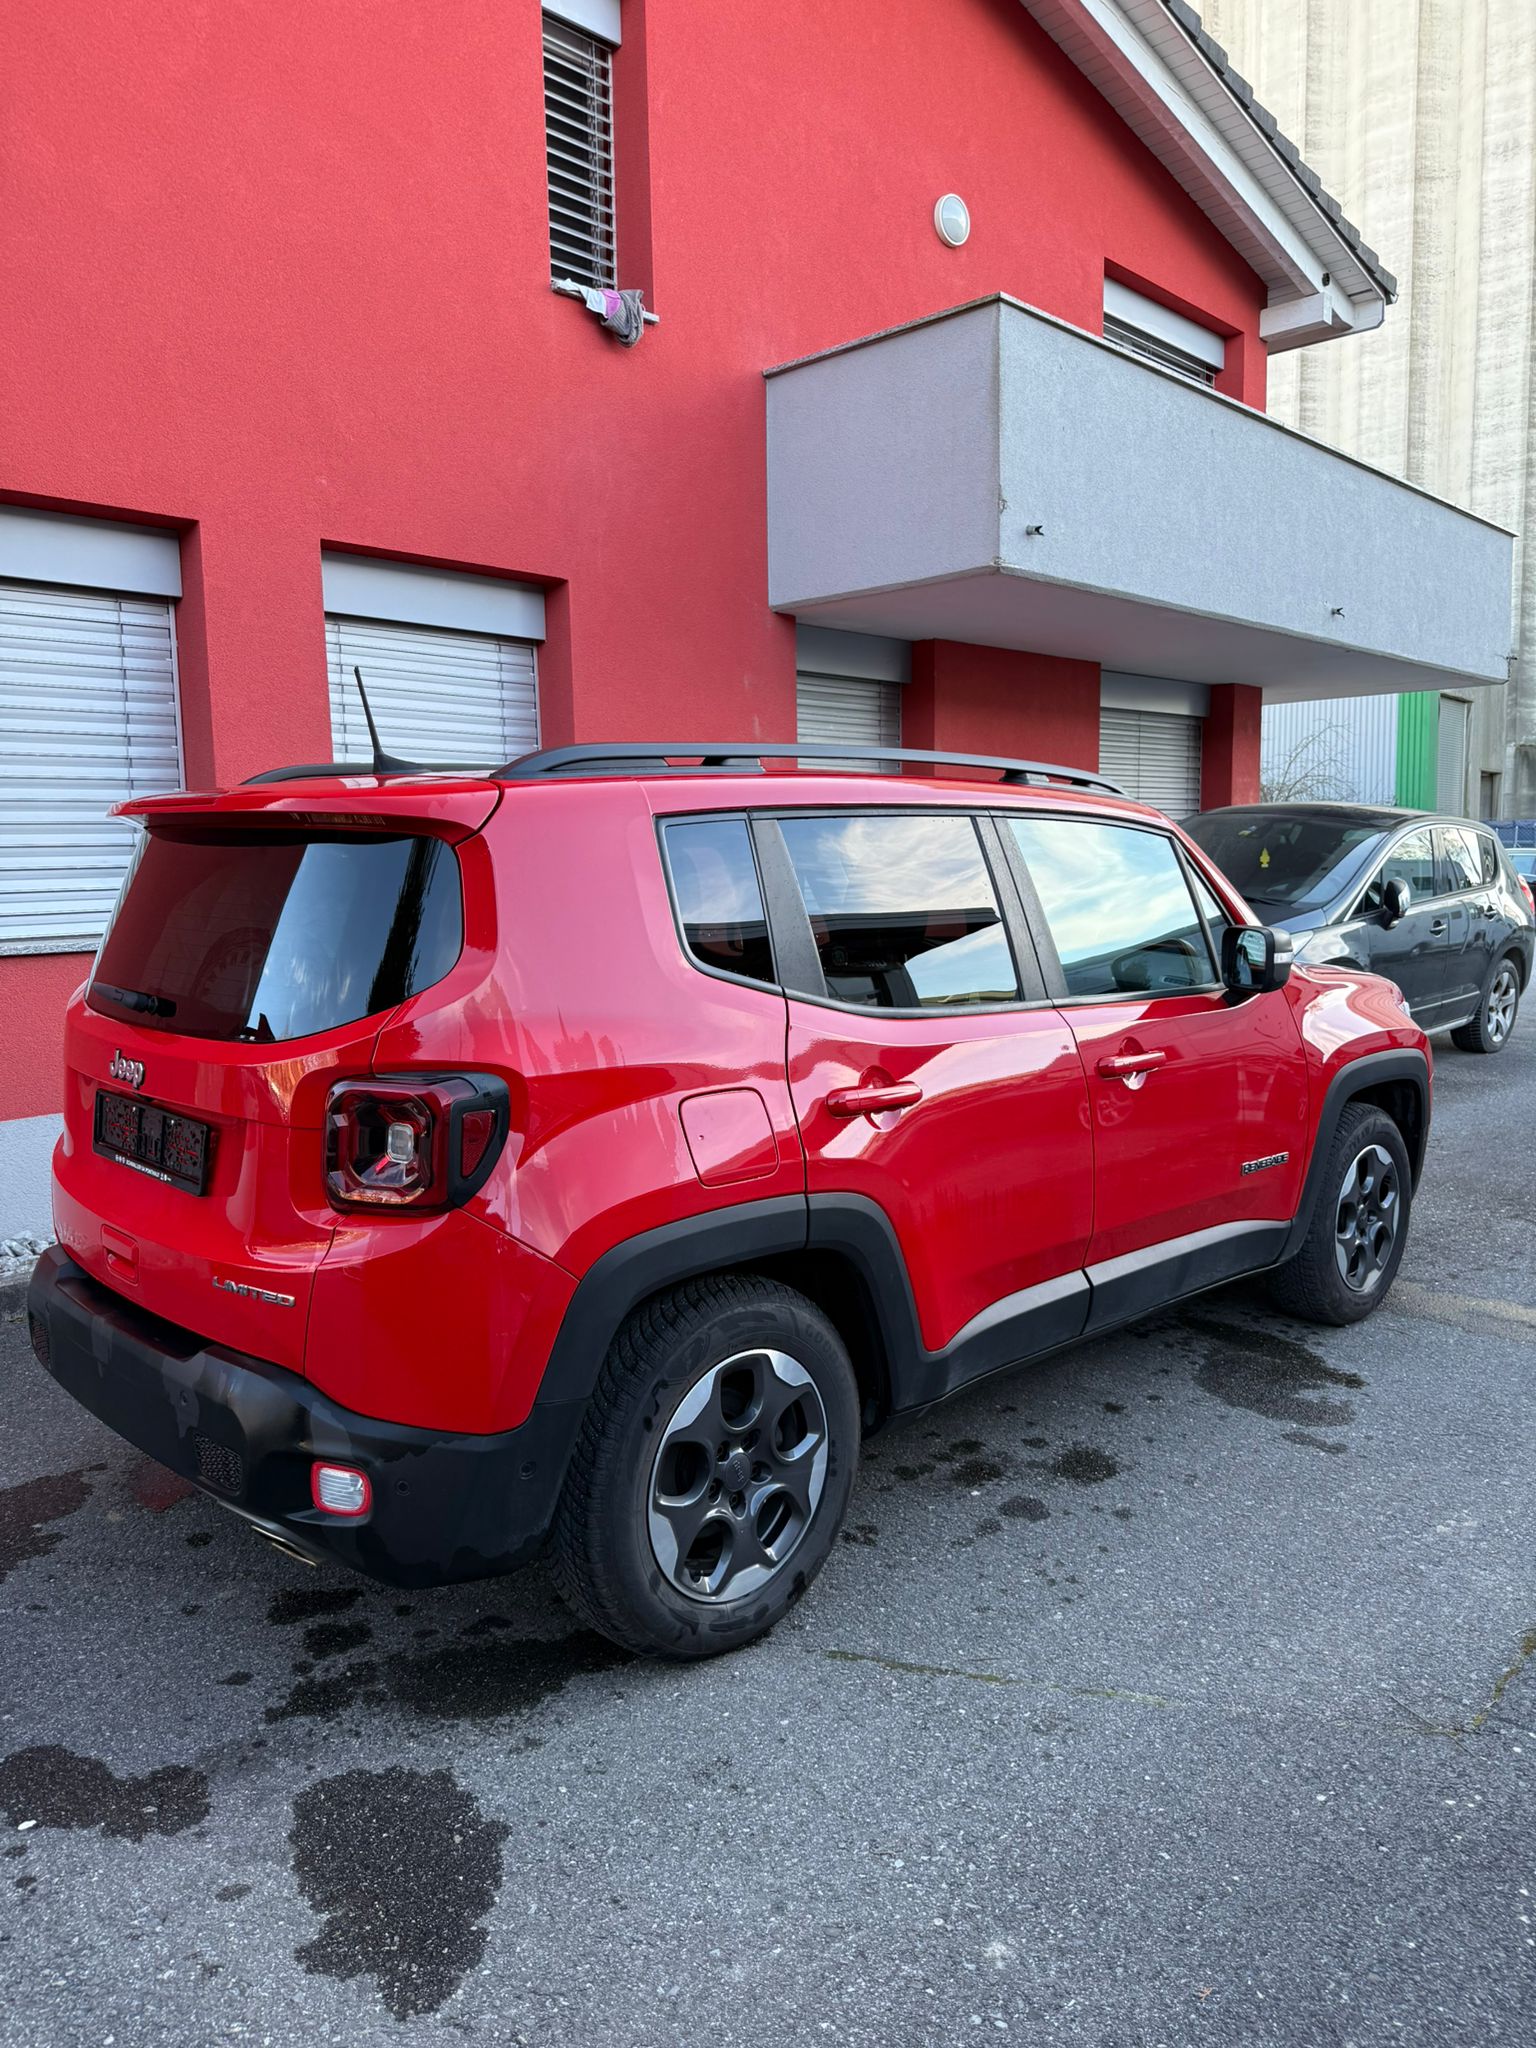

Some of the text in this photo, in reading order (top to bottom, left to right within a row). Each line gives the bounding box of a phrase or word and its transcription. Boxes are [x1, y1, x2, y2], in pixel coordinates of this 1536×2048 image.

[109, 1048, 145, 1088] Jeep
[1241, 1151, 1289, 1176] RENEGADE
[212, 1276, 296, 1308] LIMITED
